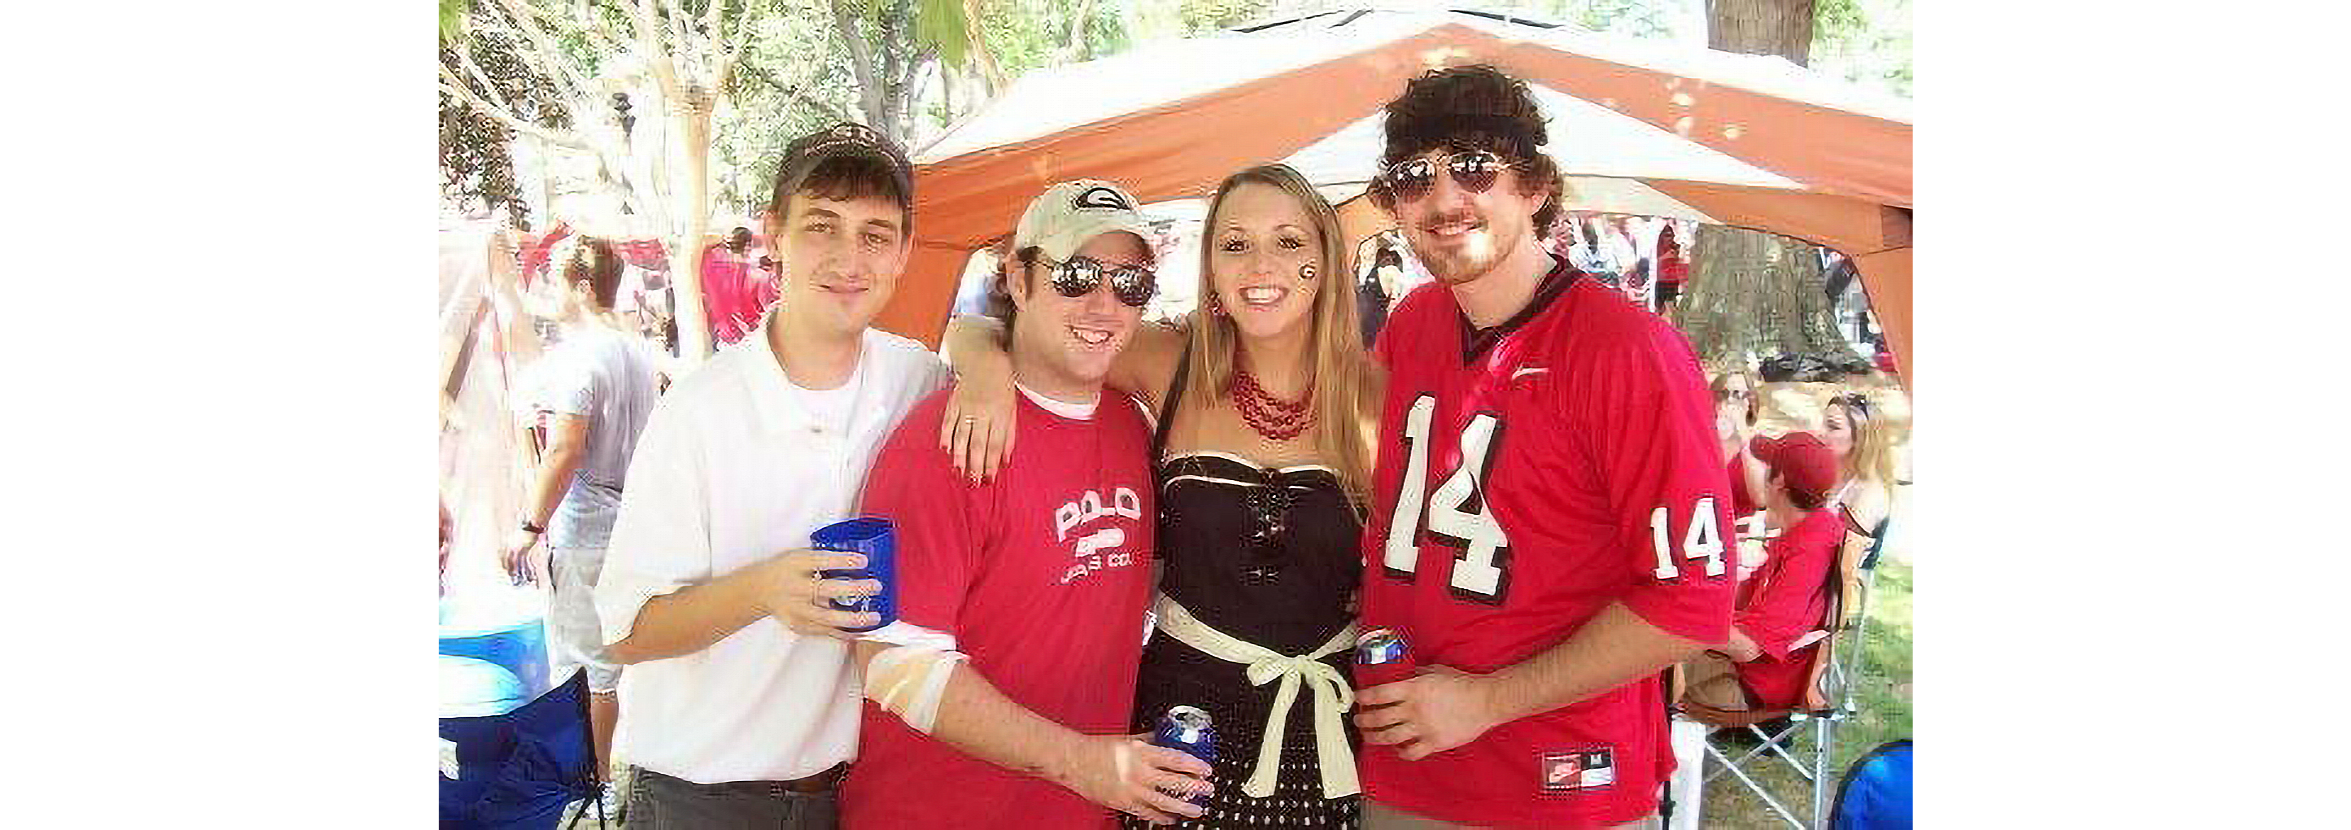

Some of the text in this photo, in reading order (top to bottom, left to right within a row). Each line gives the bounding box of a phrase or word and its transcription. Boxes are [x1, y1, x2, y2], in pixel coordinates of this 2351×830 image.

[1055, 487, 1141, 543] POLO
[1383, 393, 1510, 599] 14
[1650, 497, 1726, 579] 14
